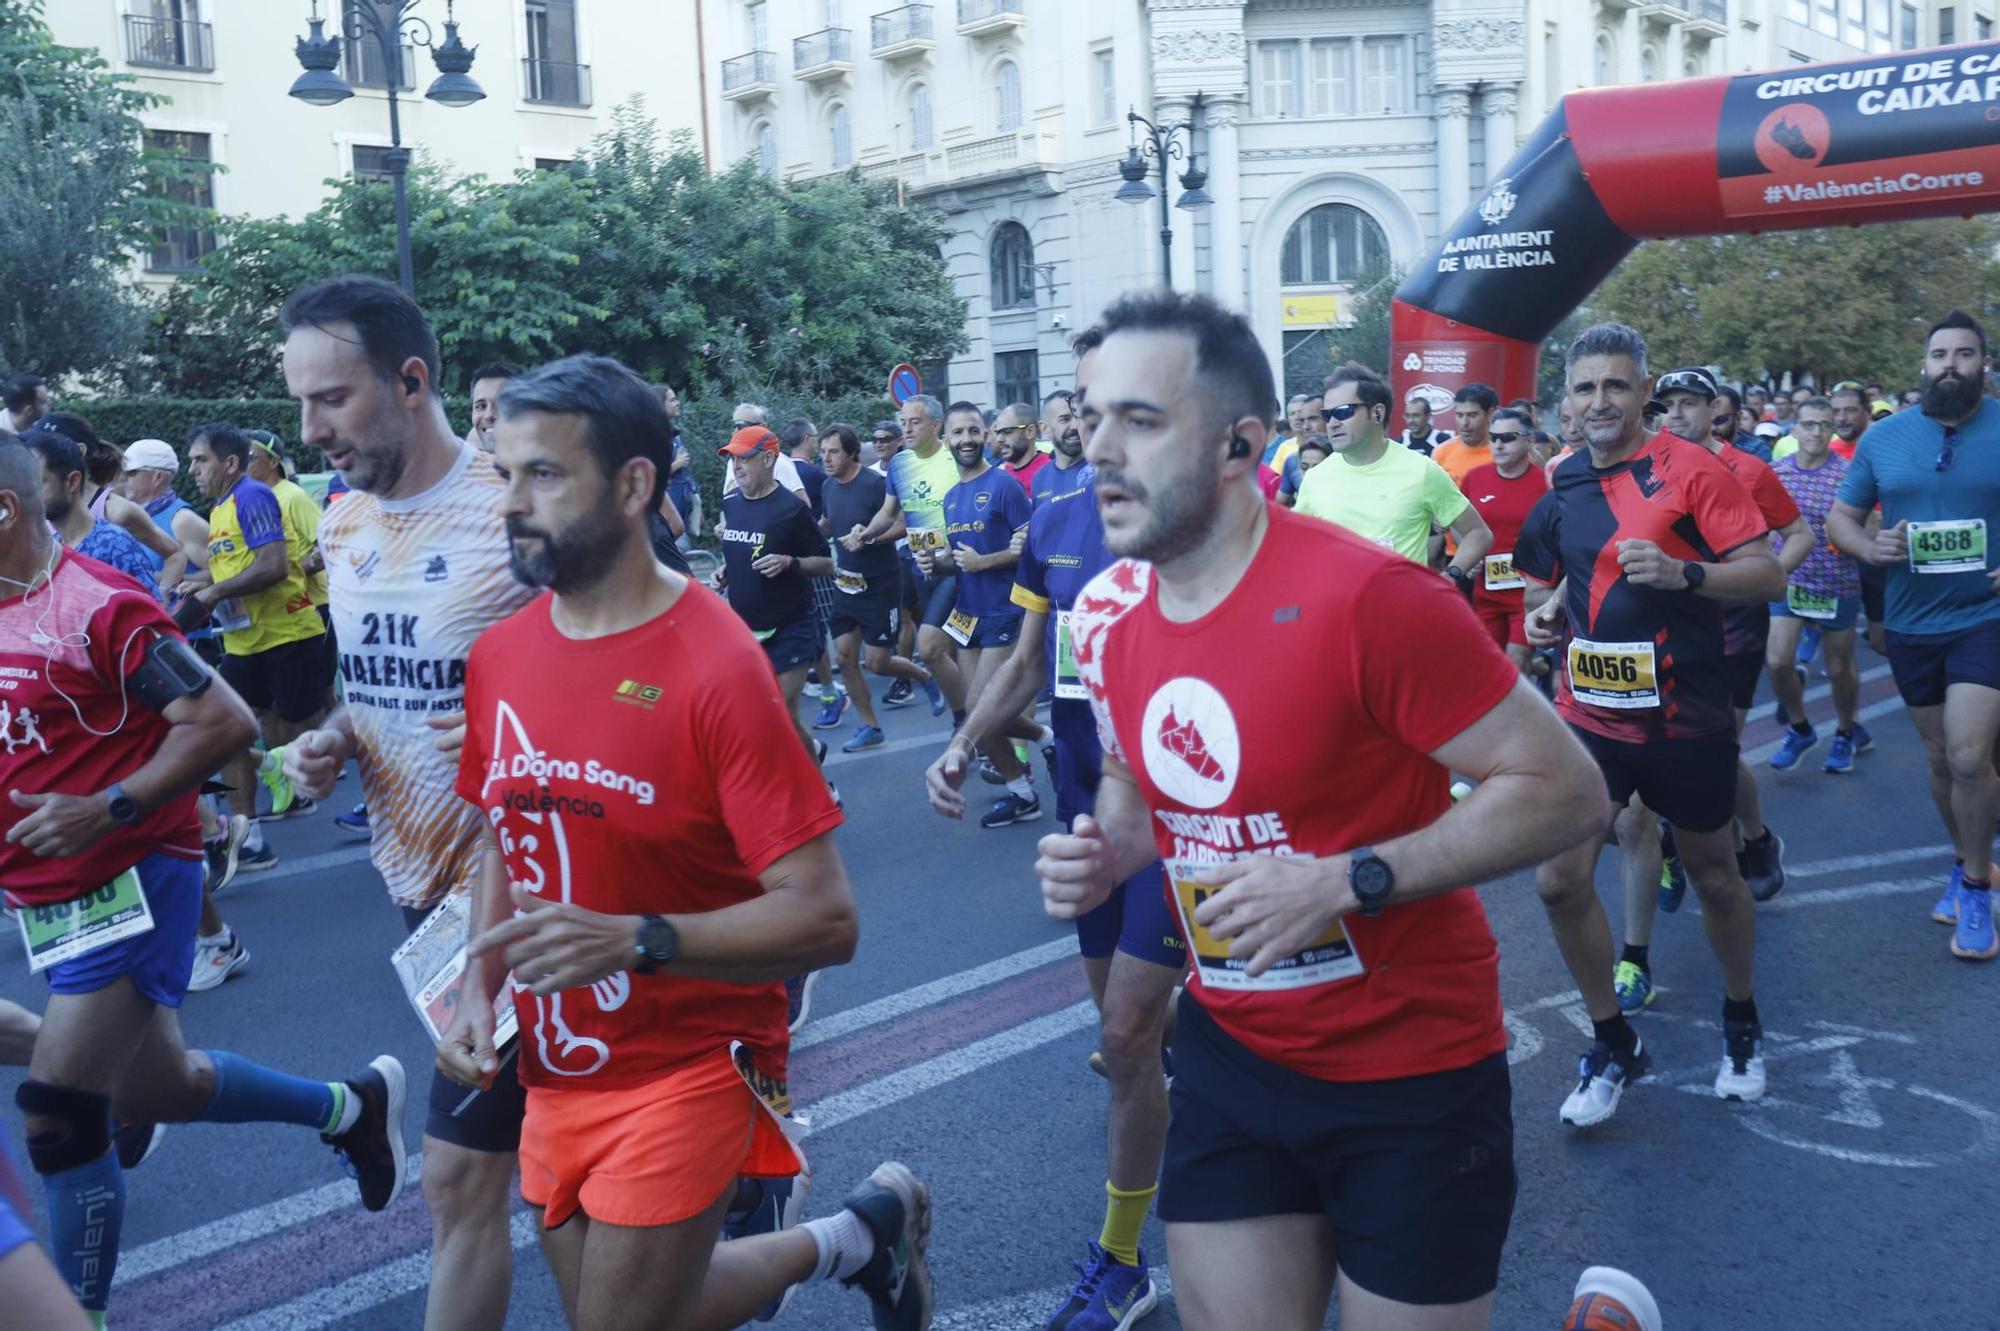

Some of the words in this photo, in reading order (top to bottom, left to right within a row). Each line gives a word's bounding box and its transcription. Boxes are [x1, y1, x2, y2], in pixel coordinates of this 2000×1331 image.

[1756, 66, 1897, 100] CIRCUIT
[1902, 59, 1955, 83] DE
[1763, 170, 1984, 204] #ValènciaCorre
[1442, 230, 1554, 255] AJUNTAMENT
[1438, 257, 1460, 273] DE
[1464, 250, 1556, 270] VALÈNCIA
[1422, 365, 1467, 373] ALFONSO
[1423, 356, 1467, 365] TRINIDAD
[1919, 529, 1972, 552] 4388
[361, 612, 419, 648] 21K
[1577, 652, 1637, 682] 4056
[404, 699, 428, 711] RUN
[511, 751, 580, 780] Dóna
[584, 760, 656, 805] Sang
[503, 785, 605, 818] València
[1155, 809, 1245, 848] CIRCUIT
[1245, 812, 1288, 845] DE
[73, 1185, 116, 1301] kalenji
